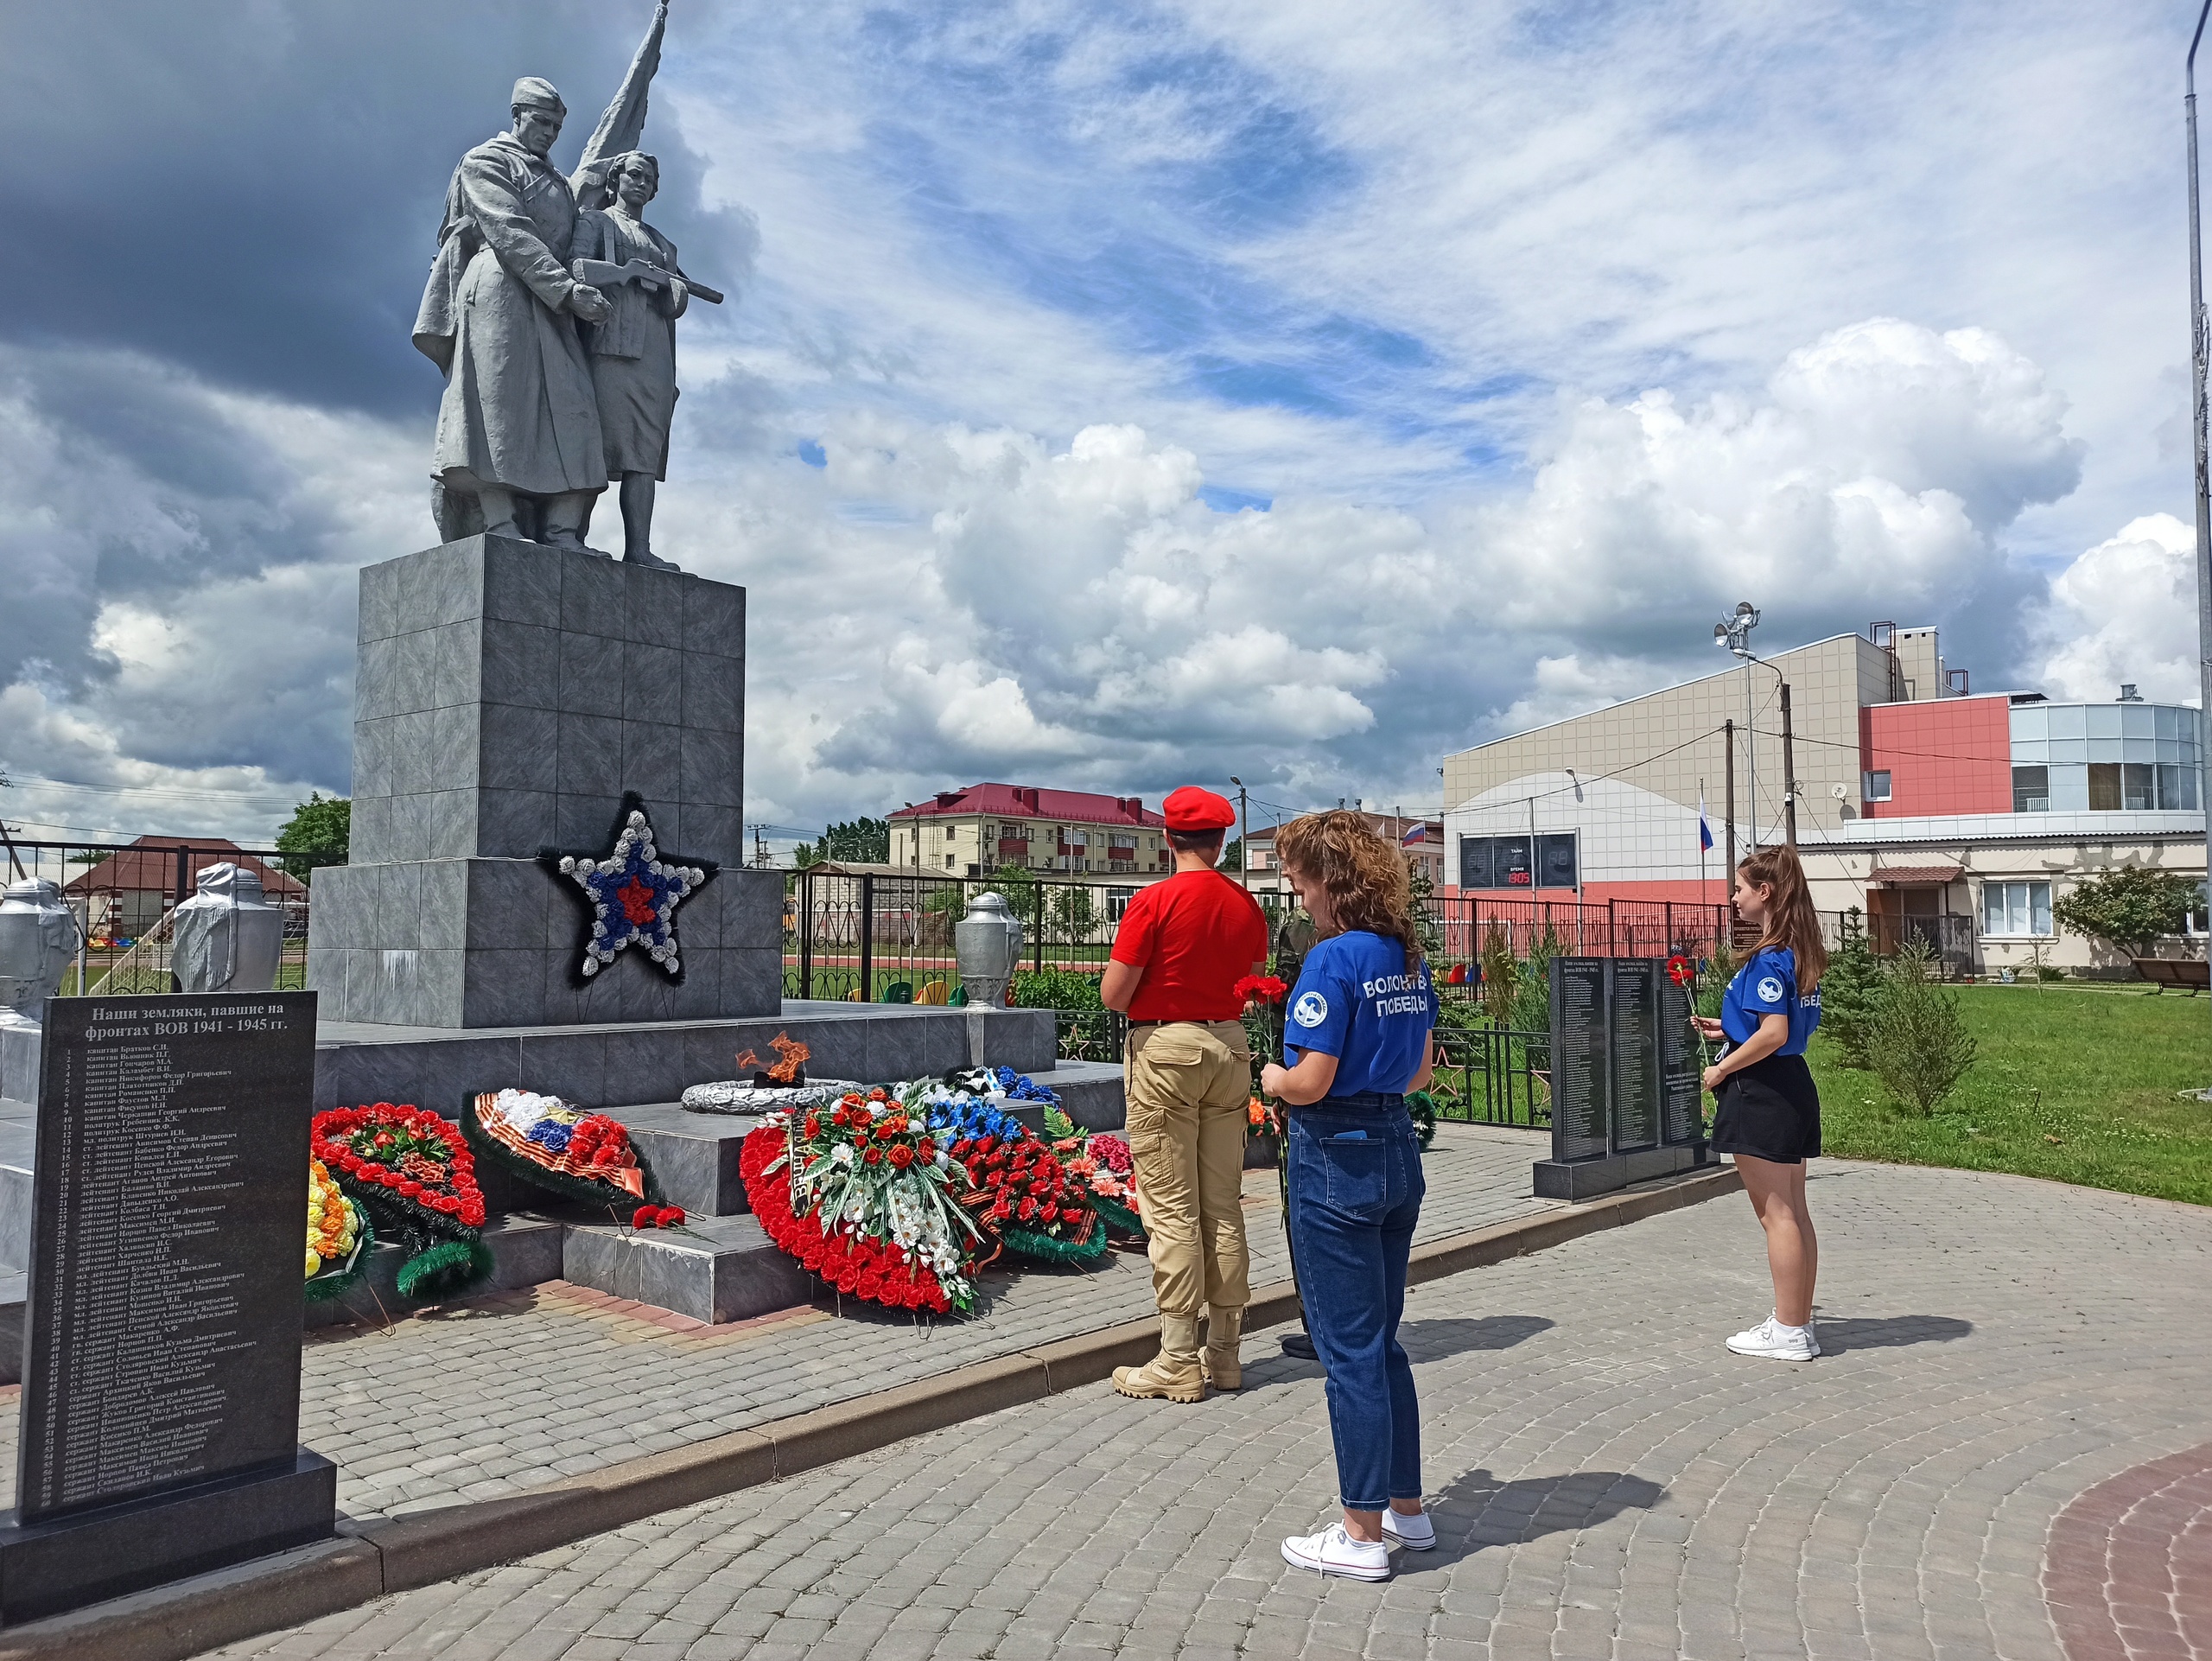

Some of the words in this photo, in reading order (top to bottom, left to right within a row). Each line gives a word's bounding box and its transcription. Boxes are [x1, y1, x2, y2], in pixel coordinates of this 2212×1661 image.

[1376, 996, 1428, 1017] ПОБЕДЫ
[92, 1008, 138, 1021] Наши
[142, 1008, 207, 1019] земляки,
[211, 1005, 264, 1016] павшие
[268, 1004, 283, 1014] на
[86, 1026, 149, 1041] фронтах
[155, 1021, 188, 1035] ВОВ
[193, 1020, 223, 1034] 1941
[238, 1018, 267, 1032] 1945
[270, 1021, 288, 1030] гг.
[81, 1188, 118, 1197] лейтенант
[79, 1219, 118, 1227] лейтенант
[78, 1233, 117, 1242] лейтенант
[91, 1276, 128, 1286] лейтенант
[90, 1291, 127, 1301] лейтенант
[90, 1298, 127, 1308] лейтенант
[88, 1314, 126, 1323] лейтенант
